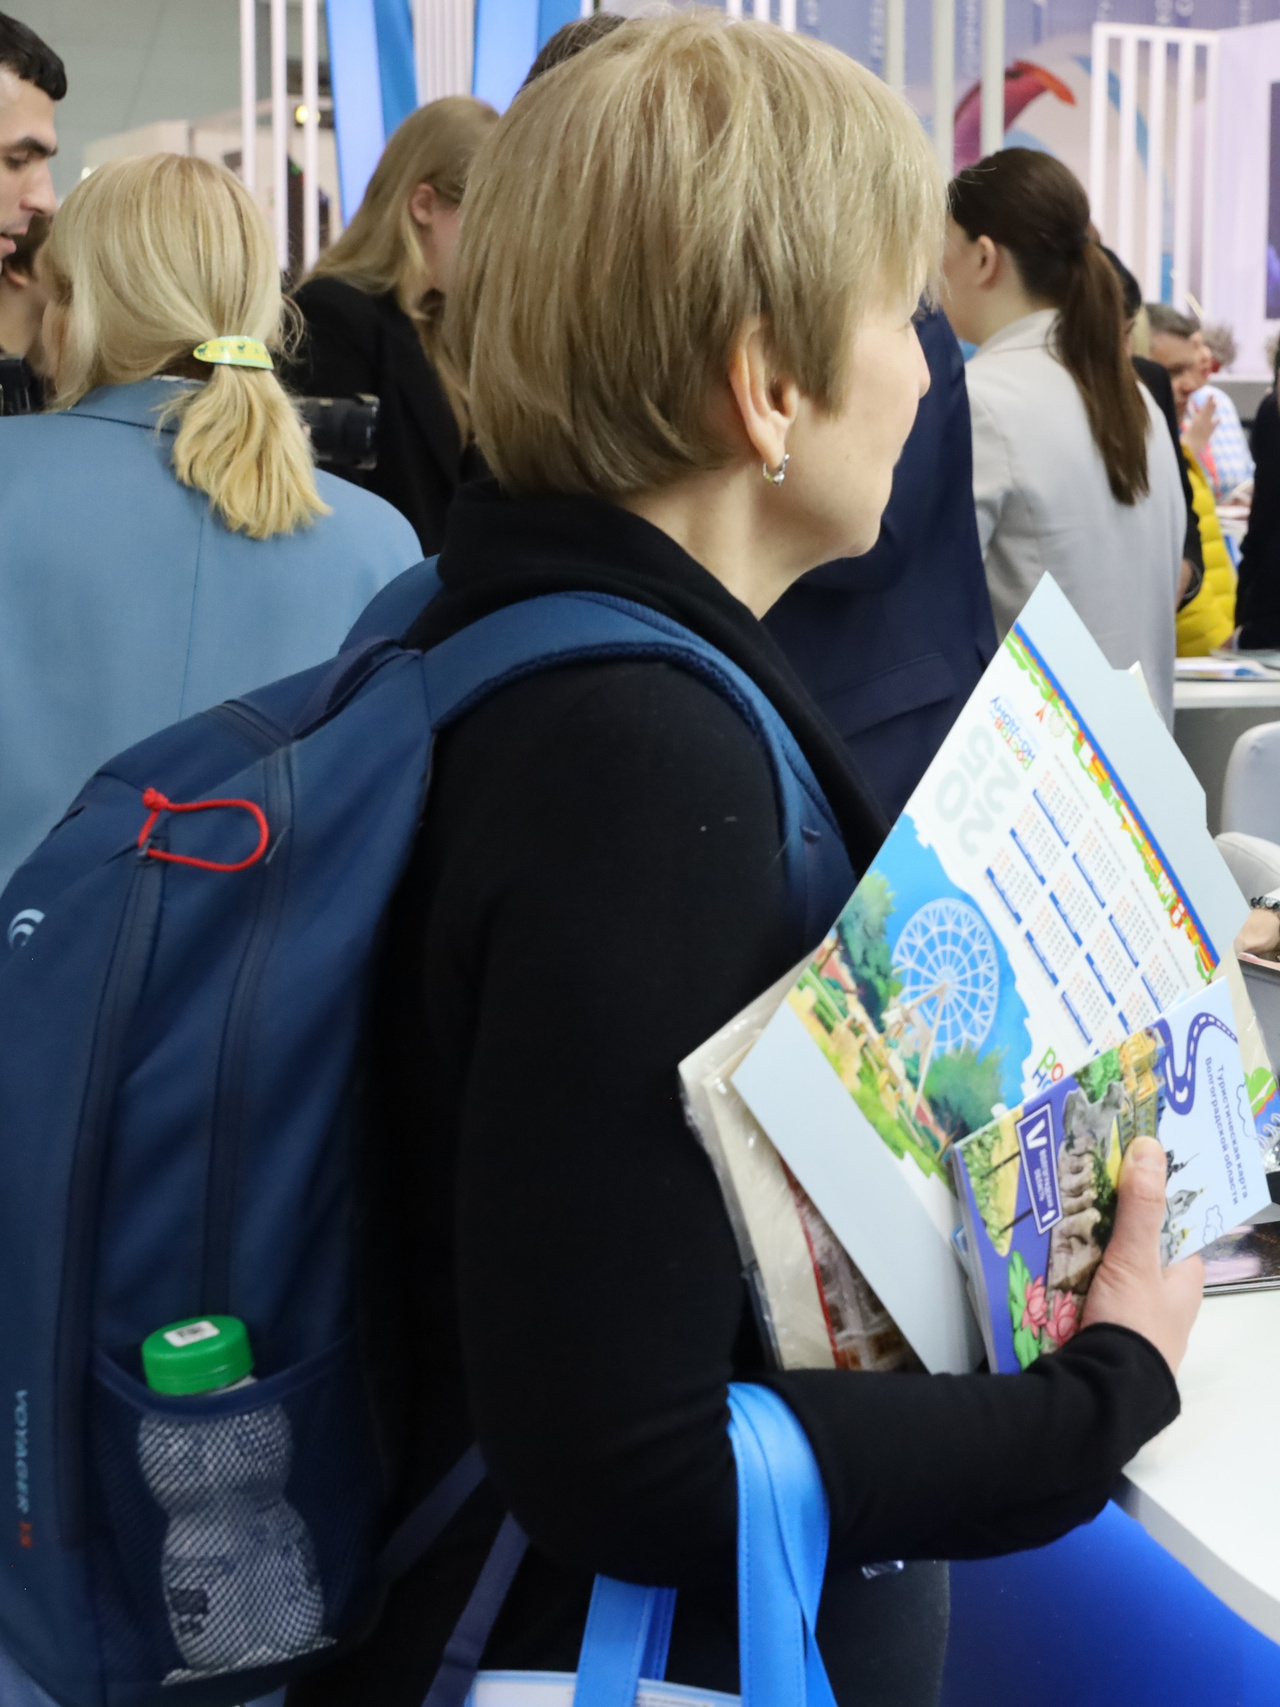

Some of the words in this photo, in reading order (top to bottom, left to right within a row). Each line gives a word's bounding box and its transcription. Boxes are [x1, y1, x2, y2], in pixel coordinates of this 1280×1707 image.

[1205, 1057, 1229, 1152] Волгоградской
[1224, 1154, 1239, 1205] области
[1217, 1064, 1241, 1161] Туристическая
[1236, 1162, 1248, 1199] карта
